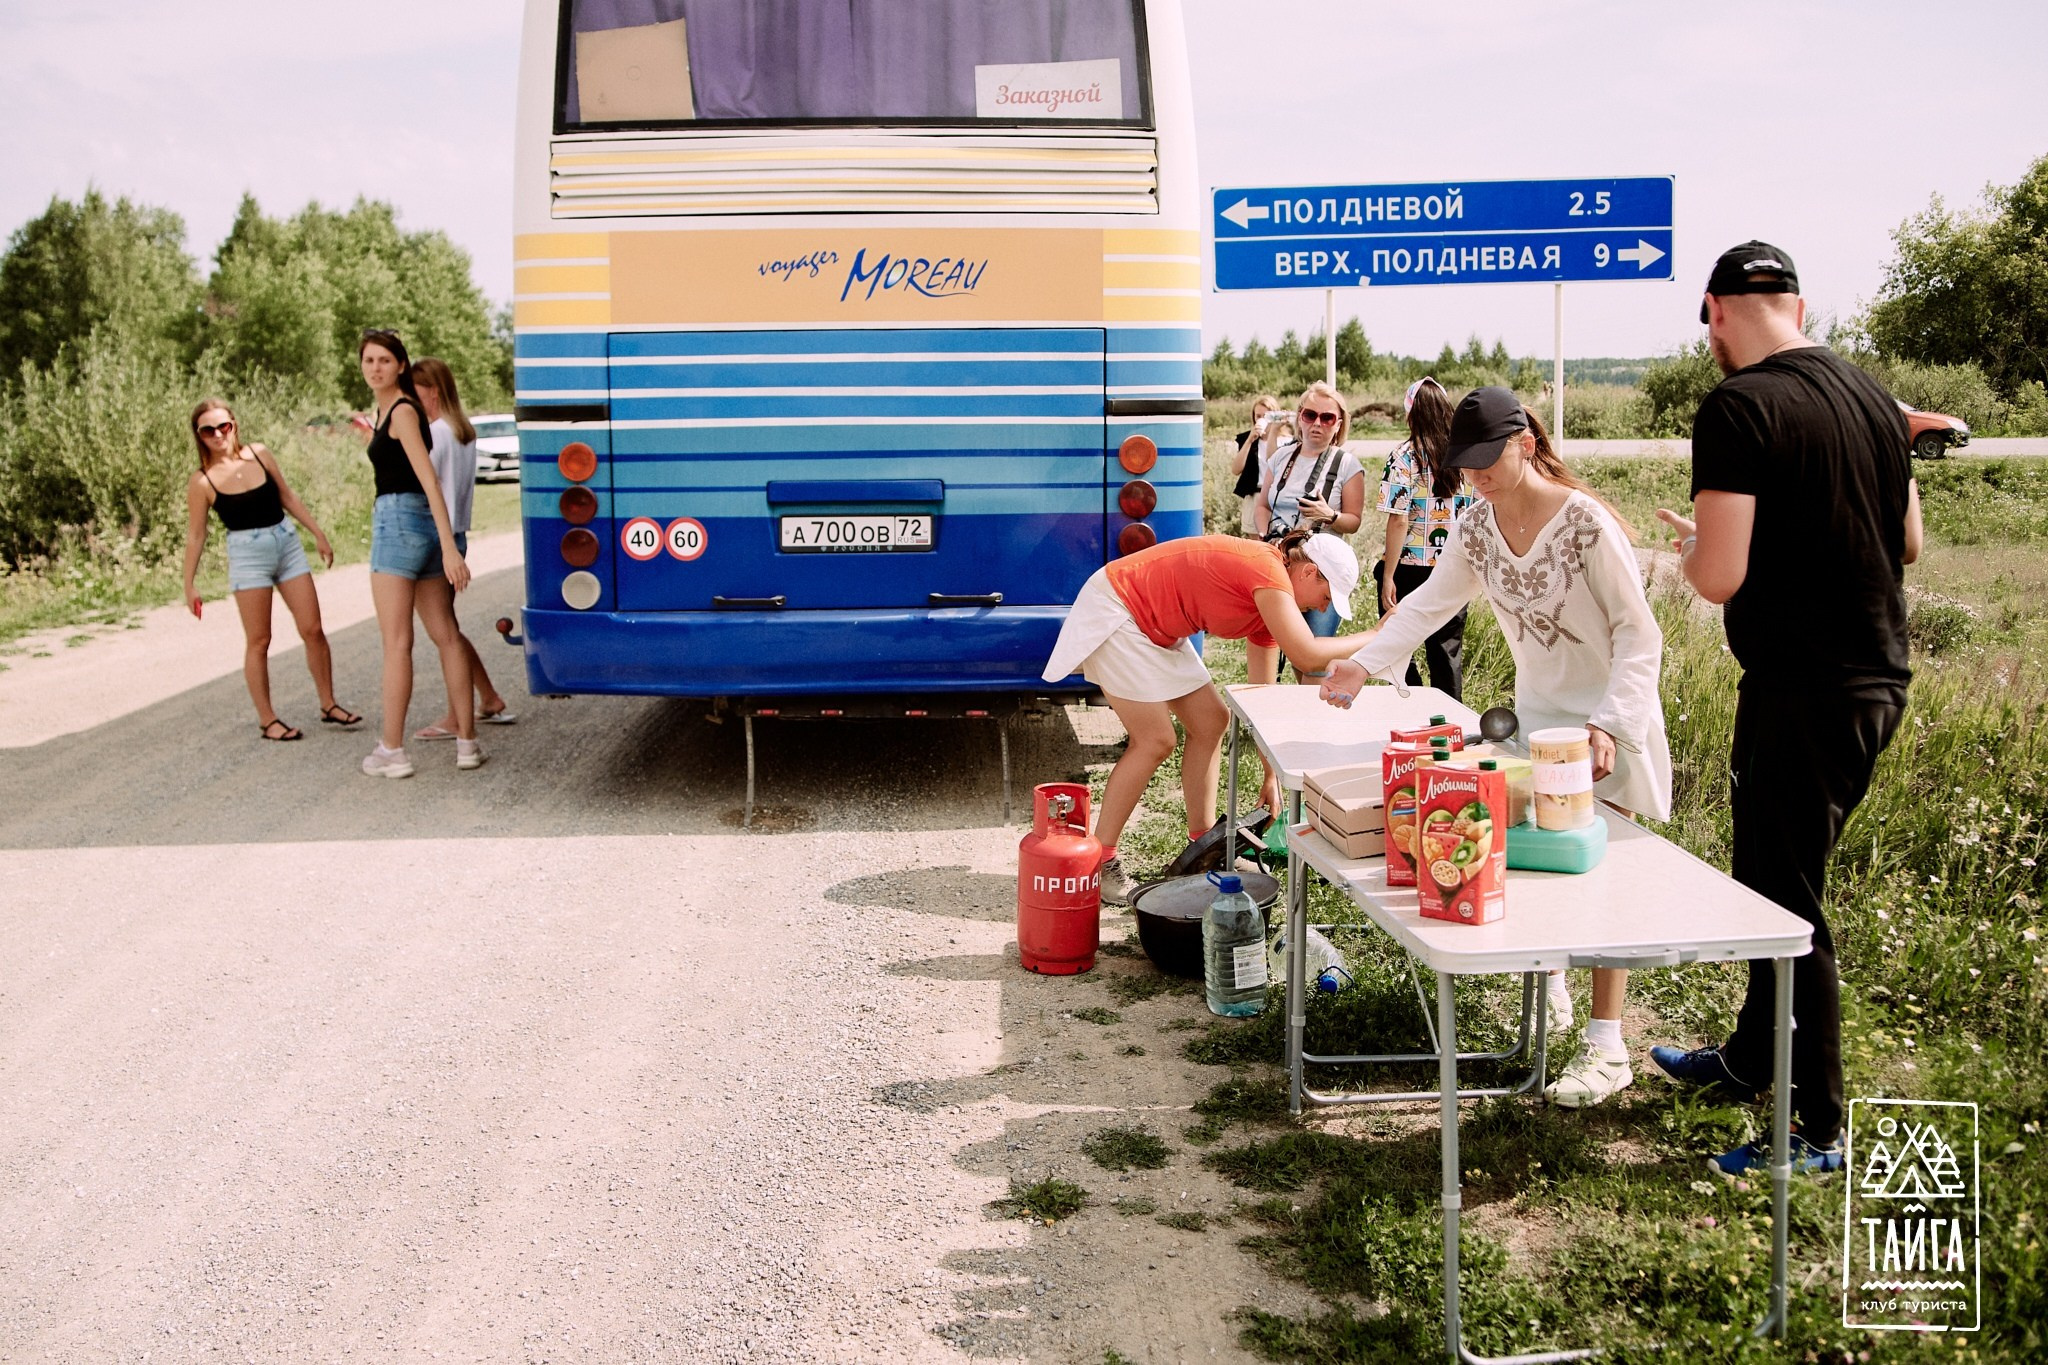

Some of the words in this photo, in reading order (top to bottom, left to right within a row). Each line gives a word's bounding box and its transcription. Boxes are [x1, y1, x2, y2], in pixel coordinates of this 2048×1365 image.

[995, 82, 1103, 113] Заказной
[1273, 187, 1464, 226] ПОЛДНЕВОЙ
[1568, 191, 1612, 217] 2.5
[1275, 250, 1360, 276] ВЕРХ.
[1372, 245, 1561, 276] ПОЛДНЕВАЯ
[1593, 242, 1611, 268] 9
[757, 250, 840, 282] voyager
[840, 247, 989, 302] MOREAU
[630, 530, 655, 548] 40
[674, 530, 699, 548] 60
[898, 519, 922, 537] 72
[1542, 749, 1561, 760] diet
[1420, 775, 1478, 805] Любимый
[1033, 871, 1102, 894] ПРОПА
